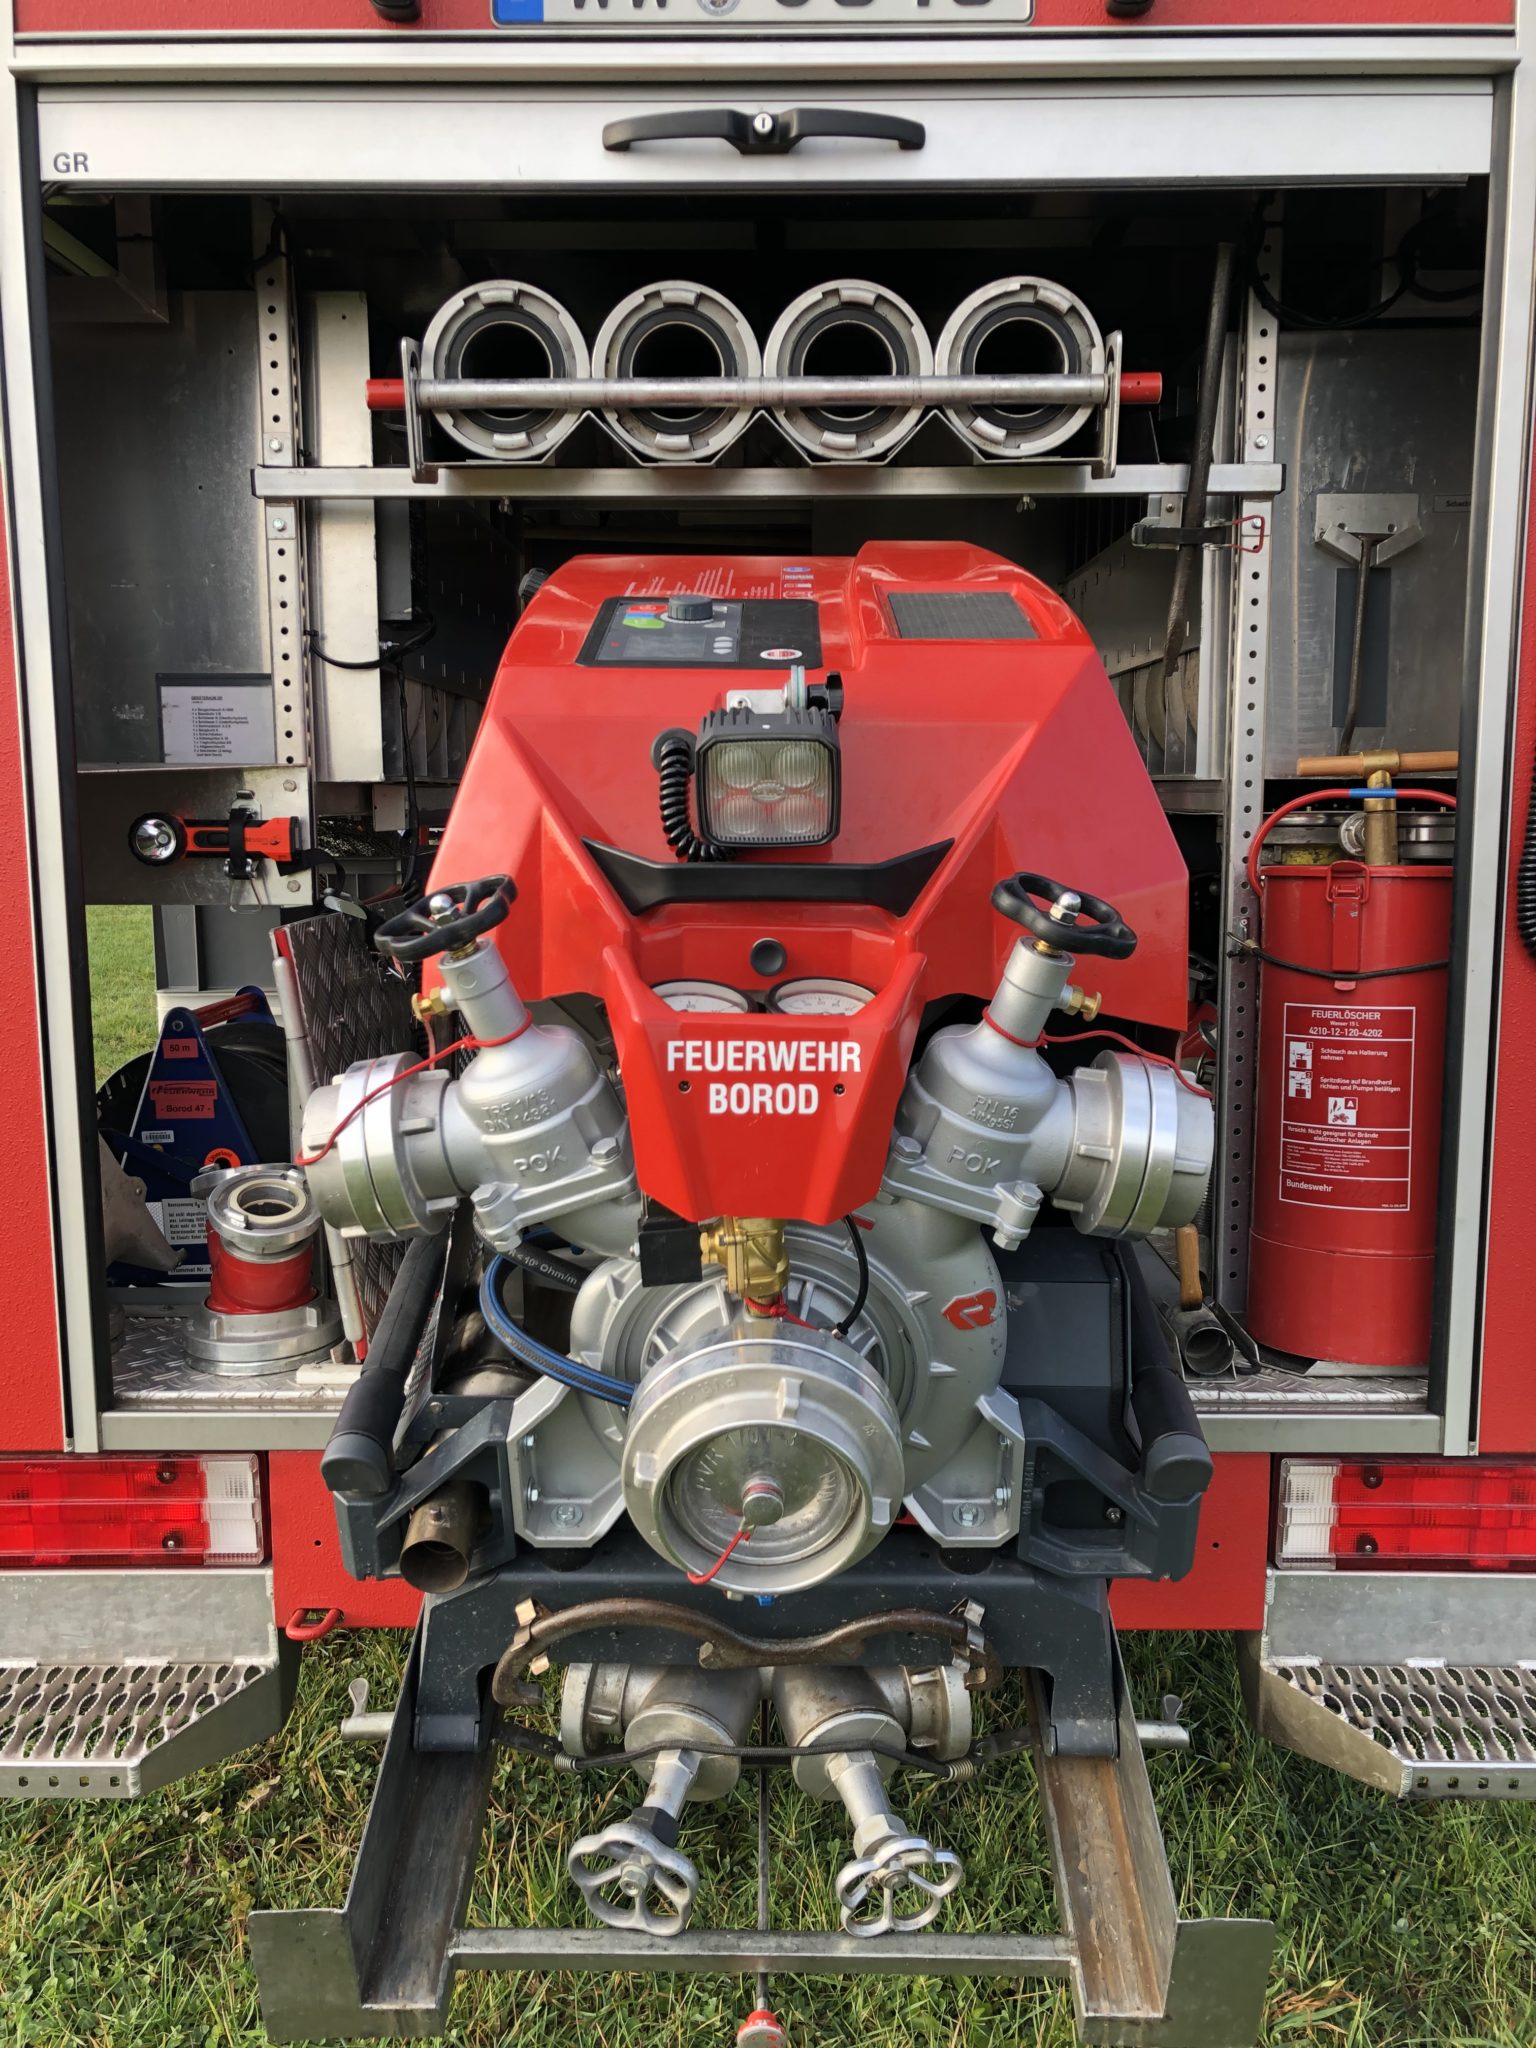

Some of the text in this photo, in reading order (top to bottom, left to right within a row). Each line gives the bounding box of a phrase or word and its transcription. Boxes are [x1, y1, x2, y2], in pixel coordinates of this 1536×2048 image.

[53, 151, 89, 174] GR
[1311, 1009, 1382, 1021] FEUERLÖSCHER
[1309, 1026, 1383, 1038] 4210-12-120-4202
[170, 1044, 180, 1052] 50
[1320, 1047, 1346, 1056] Schlauch
[1359, 1049, 1388, 1058] Halterung
[667, 1040, 862, 1073] FEUERWEHR
[1352, 1084, 1374, 1092] Pumpe
[709, 1082, 819, 1115] BOROD
[1346, 1099, 1355, 1108] A
[166, 1104, 193, 1113] Borod
[194, 1104, 206, 1112] 47
[1003, 1105, 1020, 1119] 16
[1308, 1128, 1322, 1136] Nicht
[1357, 1131, 1379, 1139] Brände
[1347, 1137, 1371, 1145] Anlagen
[513, 1145, 567, 1177] POK
[948, 1144, 1001, 1175] POK
[1286, 1178, 1333, 1193] Bundeswehr
[539, 1263, 578, 1286] Ohm/m
